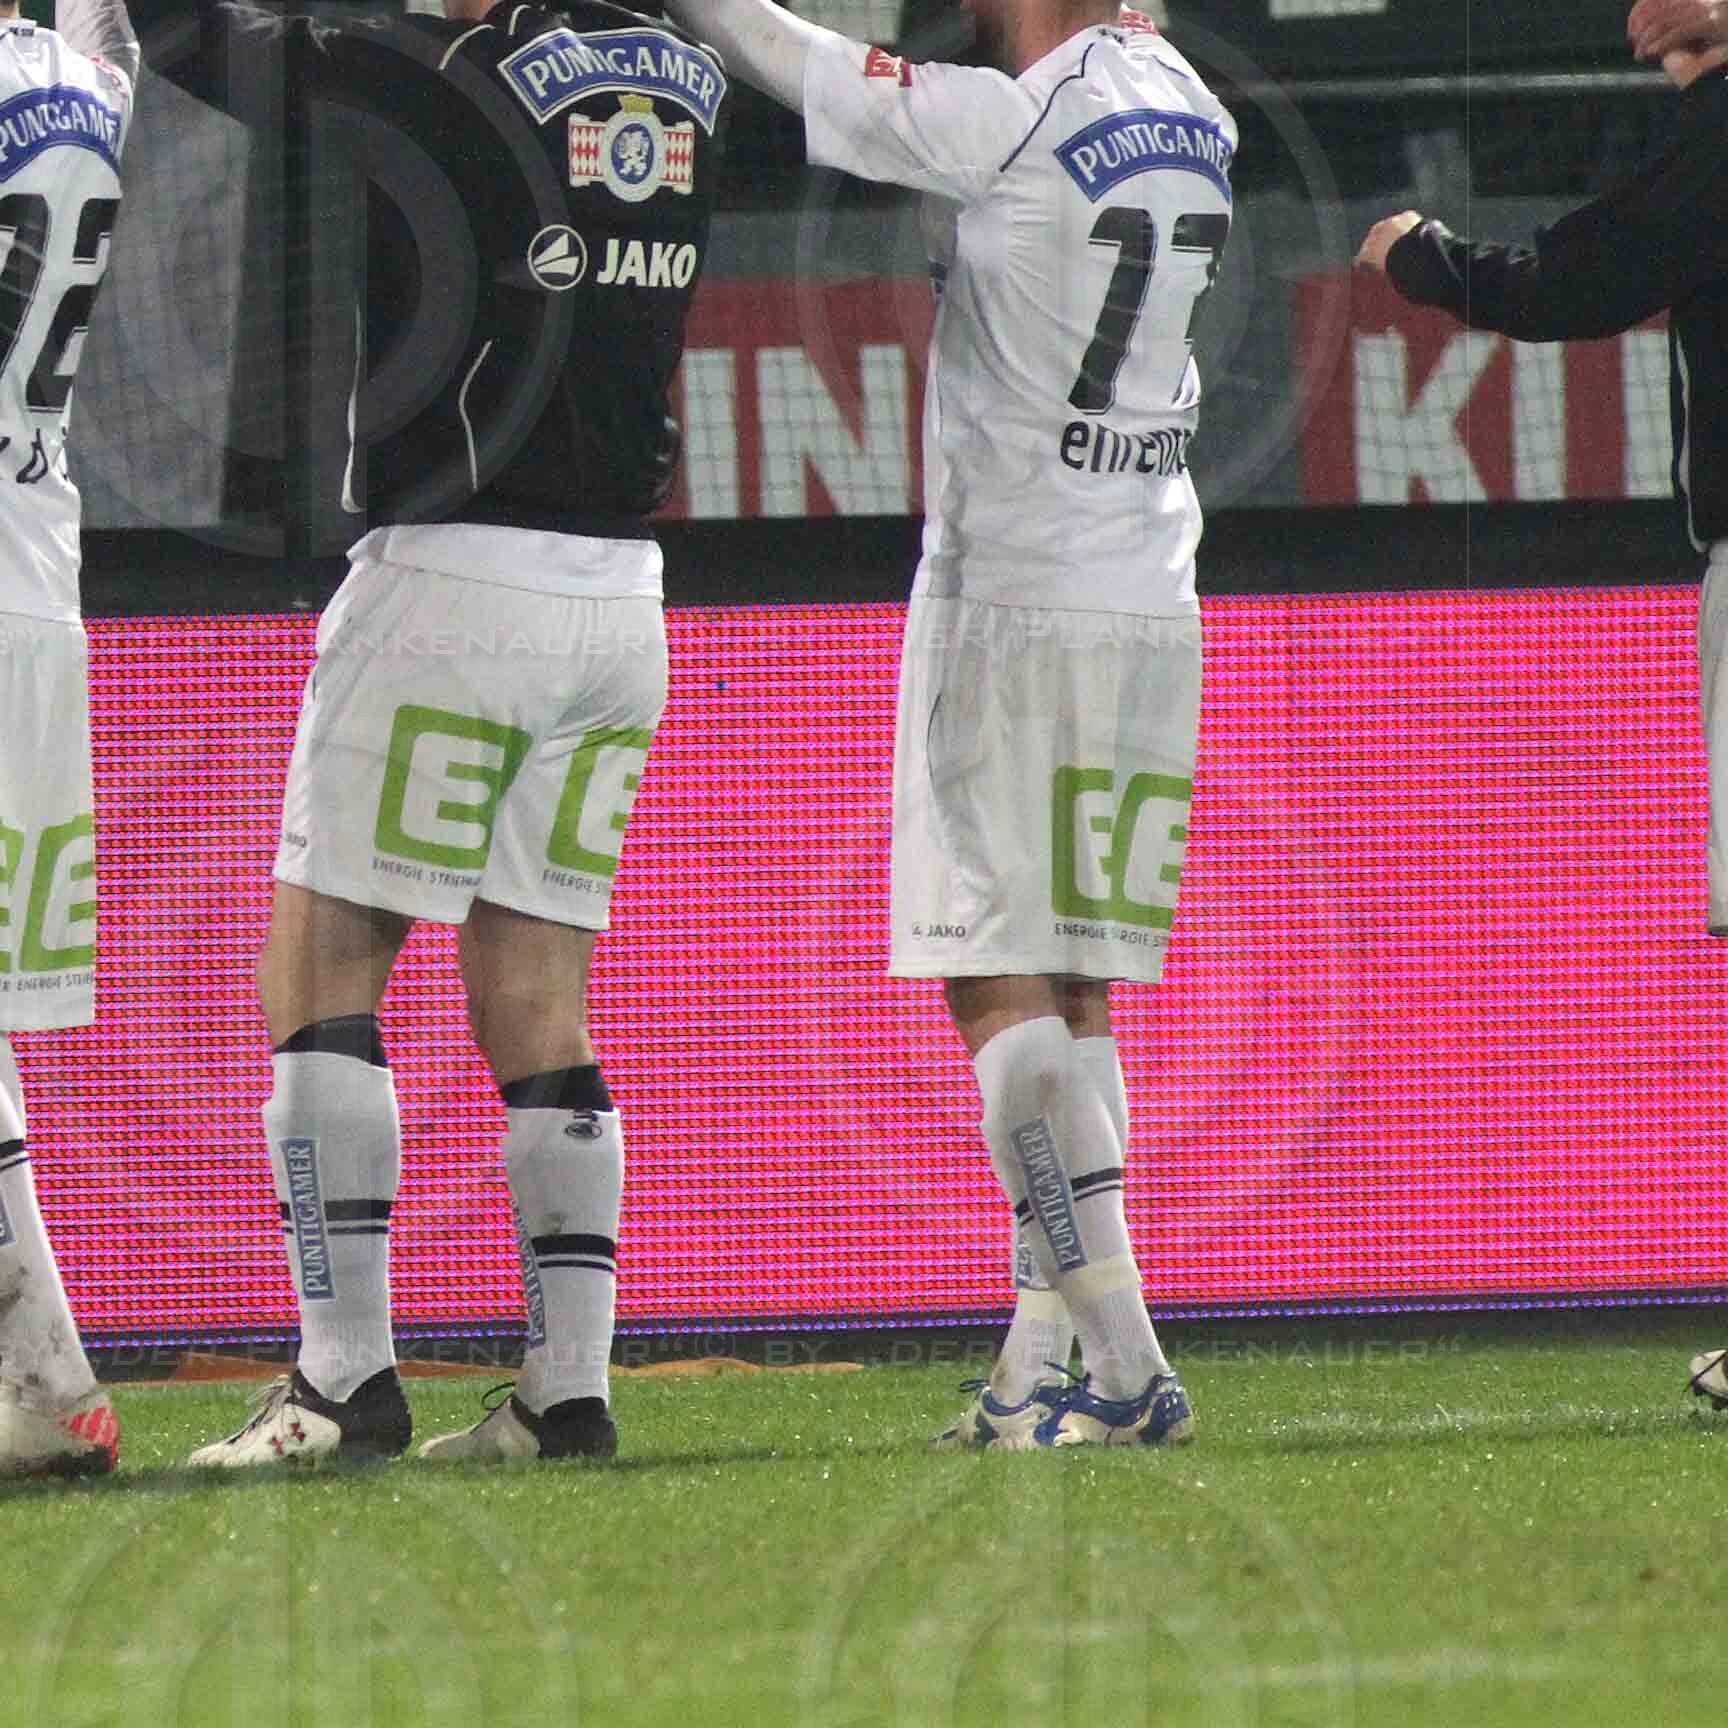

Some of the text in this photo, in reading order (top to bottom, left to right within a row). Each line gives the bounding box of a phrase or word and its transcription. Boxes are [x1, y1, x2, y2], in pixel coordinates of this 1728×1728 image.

[596, 238, 697, 289] JAKO
[920, 924, 961, 939] JAKO
[284, 1141, 331, 1298] PUNTIGAMER
[1013, 1120, 1083, 1267] PUNTIGAMER
